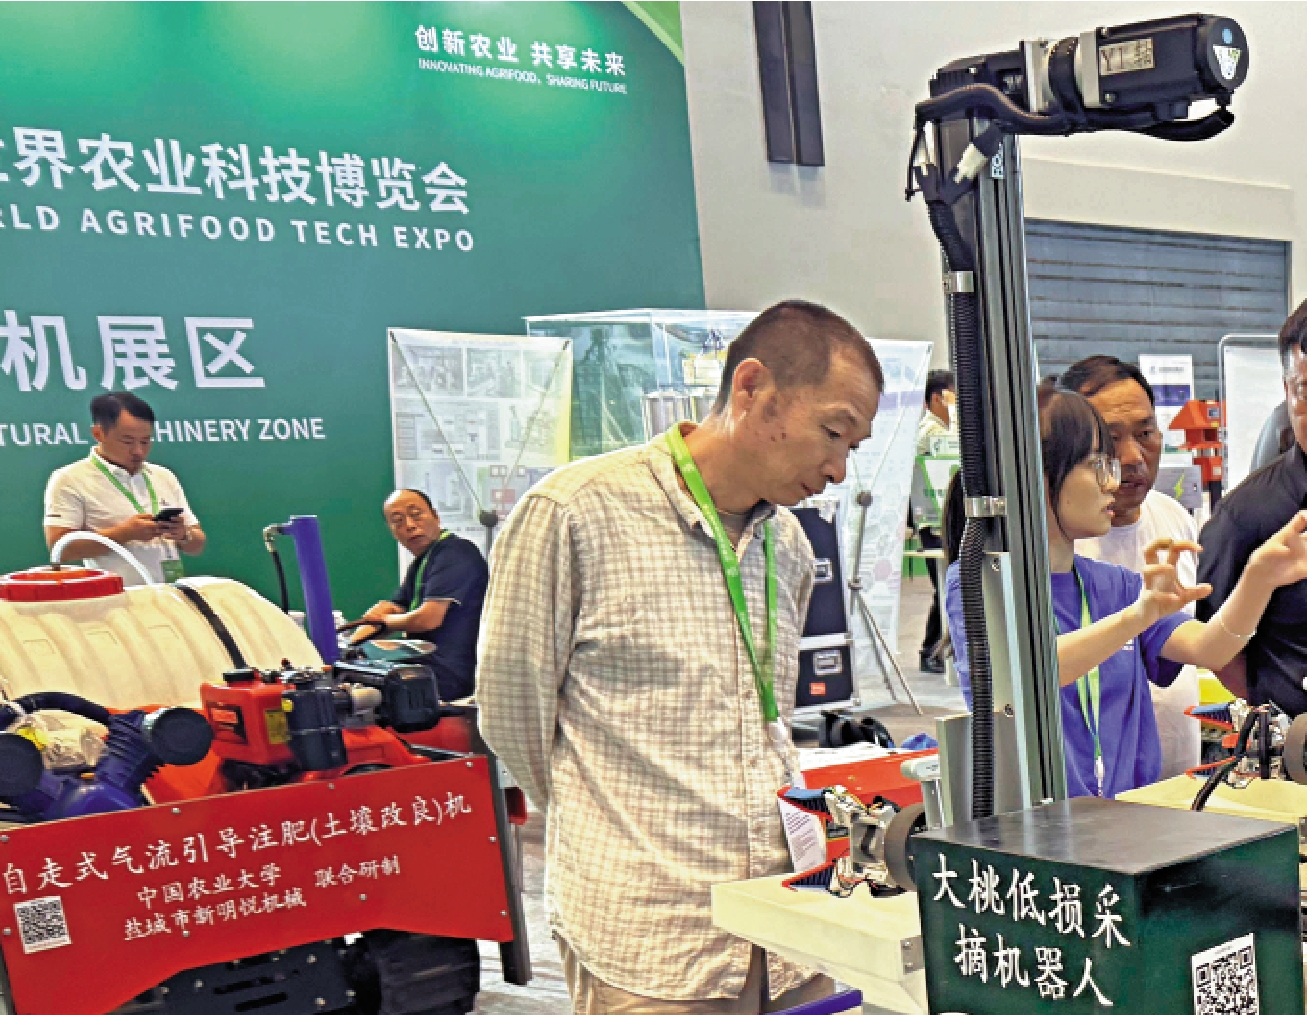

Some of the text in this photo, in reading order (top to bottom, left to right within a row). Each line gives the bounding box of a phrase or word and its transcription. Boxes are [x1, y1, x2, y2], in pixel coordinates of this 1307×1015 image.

[415, 25, 626, 76] 创新农业 共享未来
[418, 57, 483, 78] INNOVATING
[546, 73, 588, 90] SHARING
[590, 79, 628, 94] FUTURE
[0, 126, 470, 215] 界农业科技博览会
[80, 207, 276, 244] AGRIFOOD
[291, 219, 378, 248] TECH
[394, 223, 475, 252] EXPO
[0, 309, 265, 391] 机展区
[257, 416, 326, 441] ZONE
[1, 791, 472, 896] 自走式气流引导注肥(土壤改良)机
[137, 862, 282, 909] 中国农业大学
[314, 855, 400, 888] 联合研制
[124, 887, 307, 941] 盐城市新明悦机械
[931, 852, 1131, 949] 大桃低损采
[953, 922, 1114, 1007] 摘机器人
